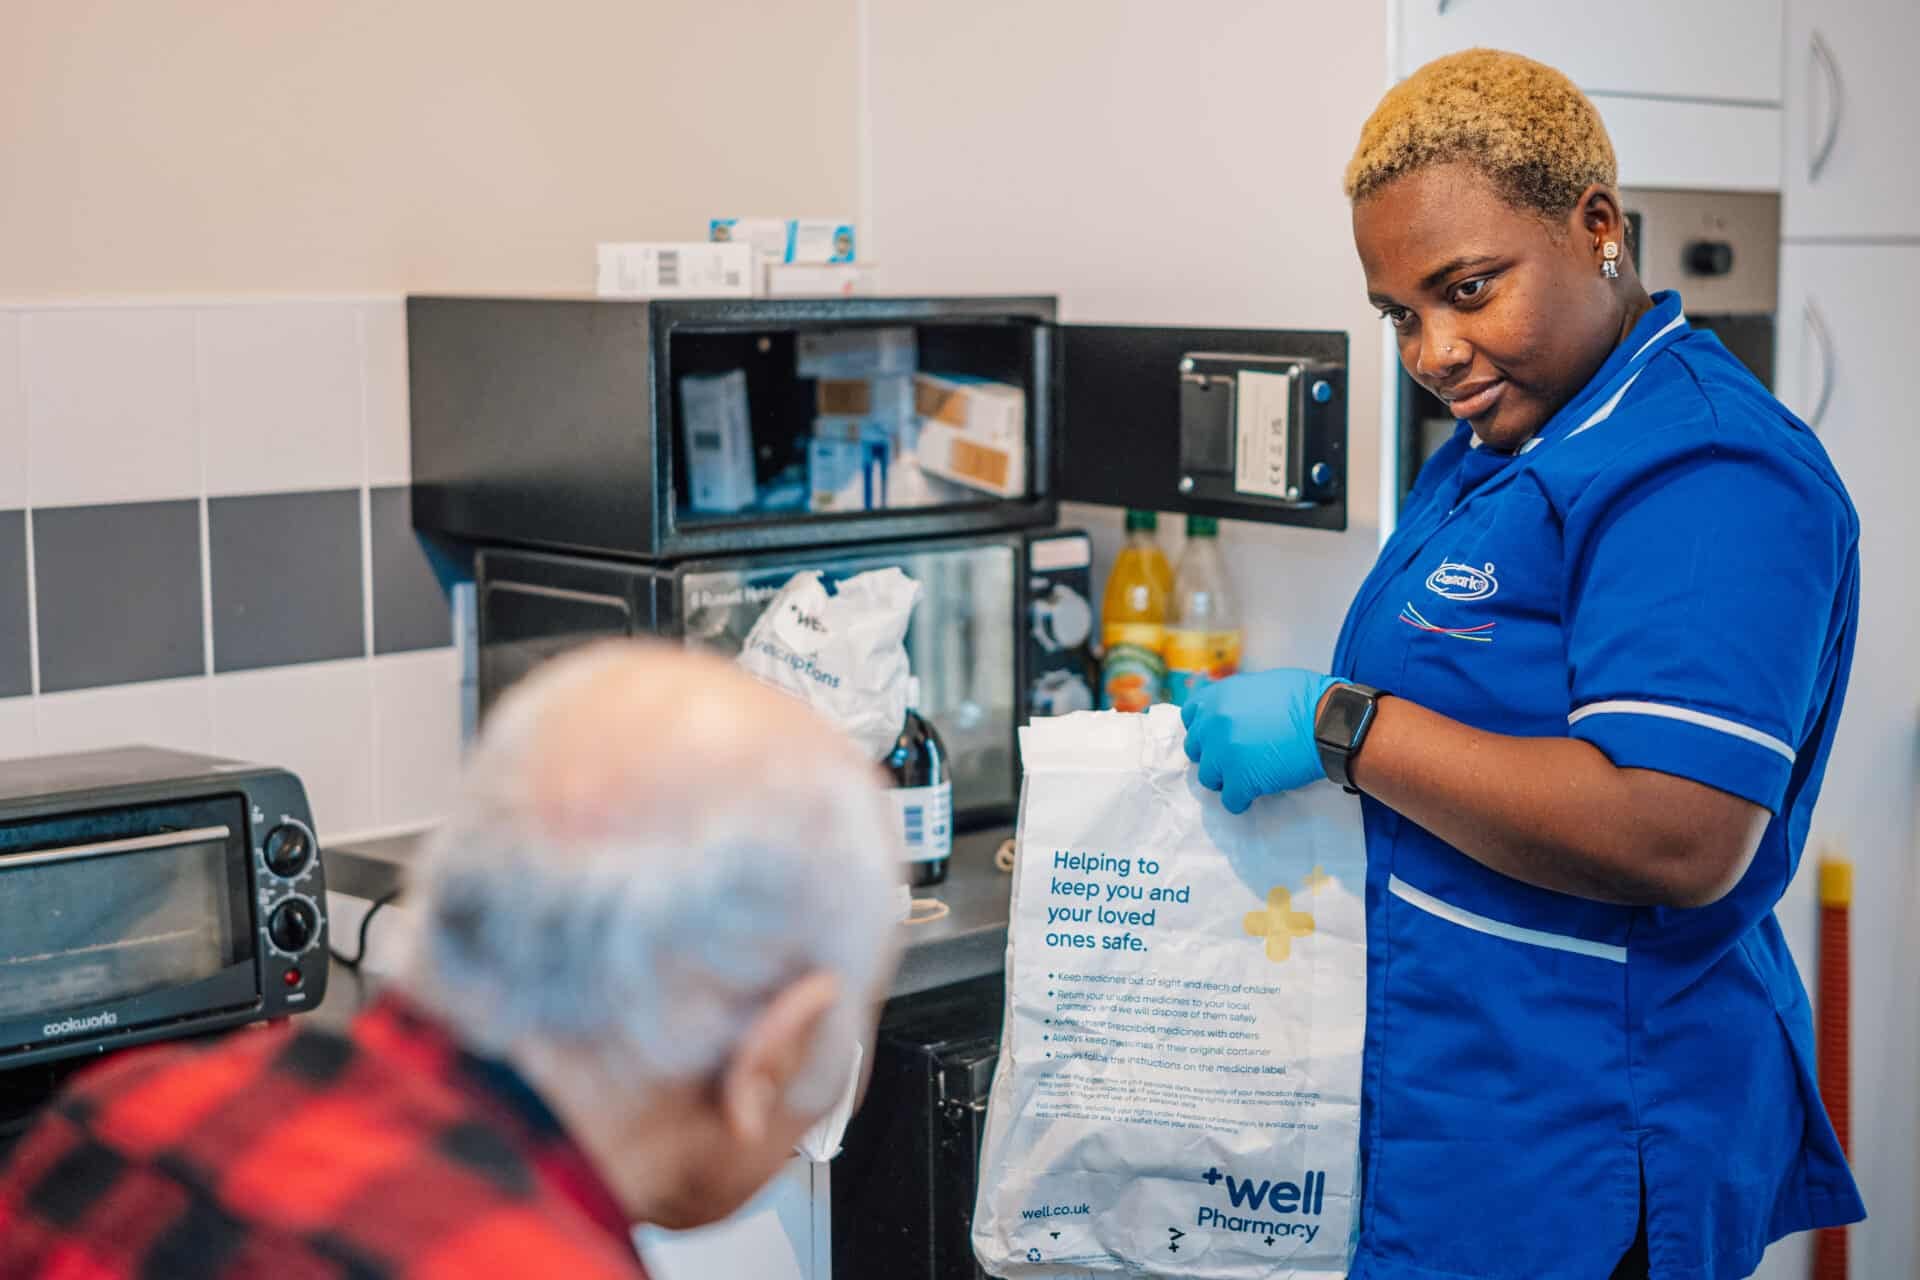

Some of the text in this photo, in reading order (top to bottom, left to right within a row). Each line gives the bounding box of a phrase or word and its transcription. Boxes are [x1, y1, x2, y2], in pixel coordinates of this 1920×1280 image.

[1054, 851, 1159, 877] Helping to
[1051, 876, 1190, 903] keep you and
[1047, 905, 1156, 926] your loved
[1046, 932, 1148, 952] ones safe.
[1058, 973, 1081, 984] Keep
[1129, 976, 1144, 985] out
[1146, 978, 1156, 986] of
[1158, 978, 1181, 989] sight
[1184, 979, 1201, 989] and
[1203, 981, 1230, 992] reach
[1231, 983, 1242, 993] of
[1243, 984, 1281, 994] children
[1086, 992, 1104, 1003] your
[1192, 999, 1202, 1007] to
[1204, 1001, 1224, 1010] your
[1226, 1001, 1250, 1010] local
[1134, 1006, 1149, 1016] will
[1190, 1010, 1200, 1018] of
[1202, 1011, 1227, 1020] them
[1230, 1013, 1256, 1024] safely
[1208, 1028, 1227, 1038] with
[1229, 1030, 1261, 1040] others
[1189, 1045, 1224, 1057] original
[1110, 1055, 1125, 1064] the
[1183, 1062, 1196, 1071] on
[1198, 1062, 1214, 1072] the
[1216, 1063, 1260, 1074] medicine
[1226, 1170, 1326, 1215] well
[1022, 1203, 1090, 1220] well.co.uk
[1198, 1206, 1320, 1244] Pharmacy
